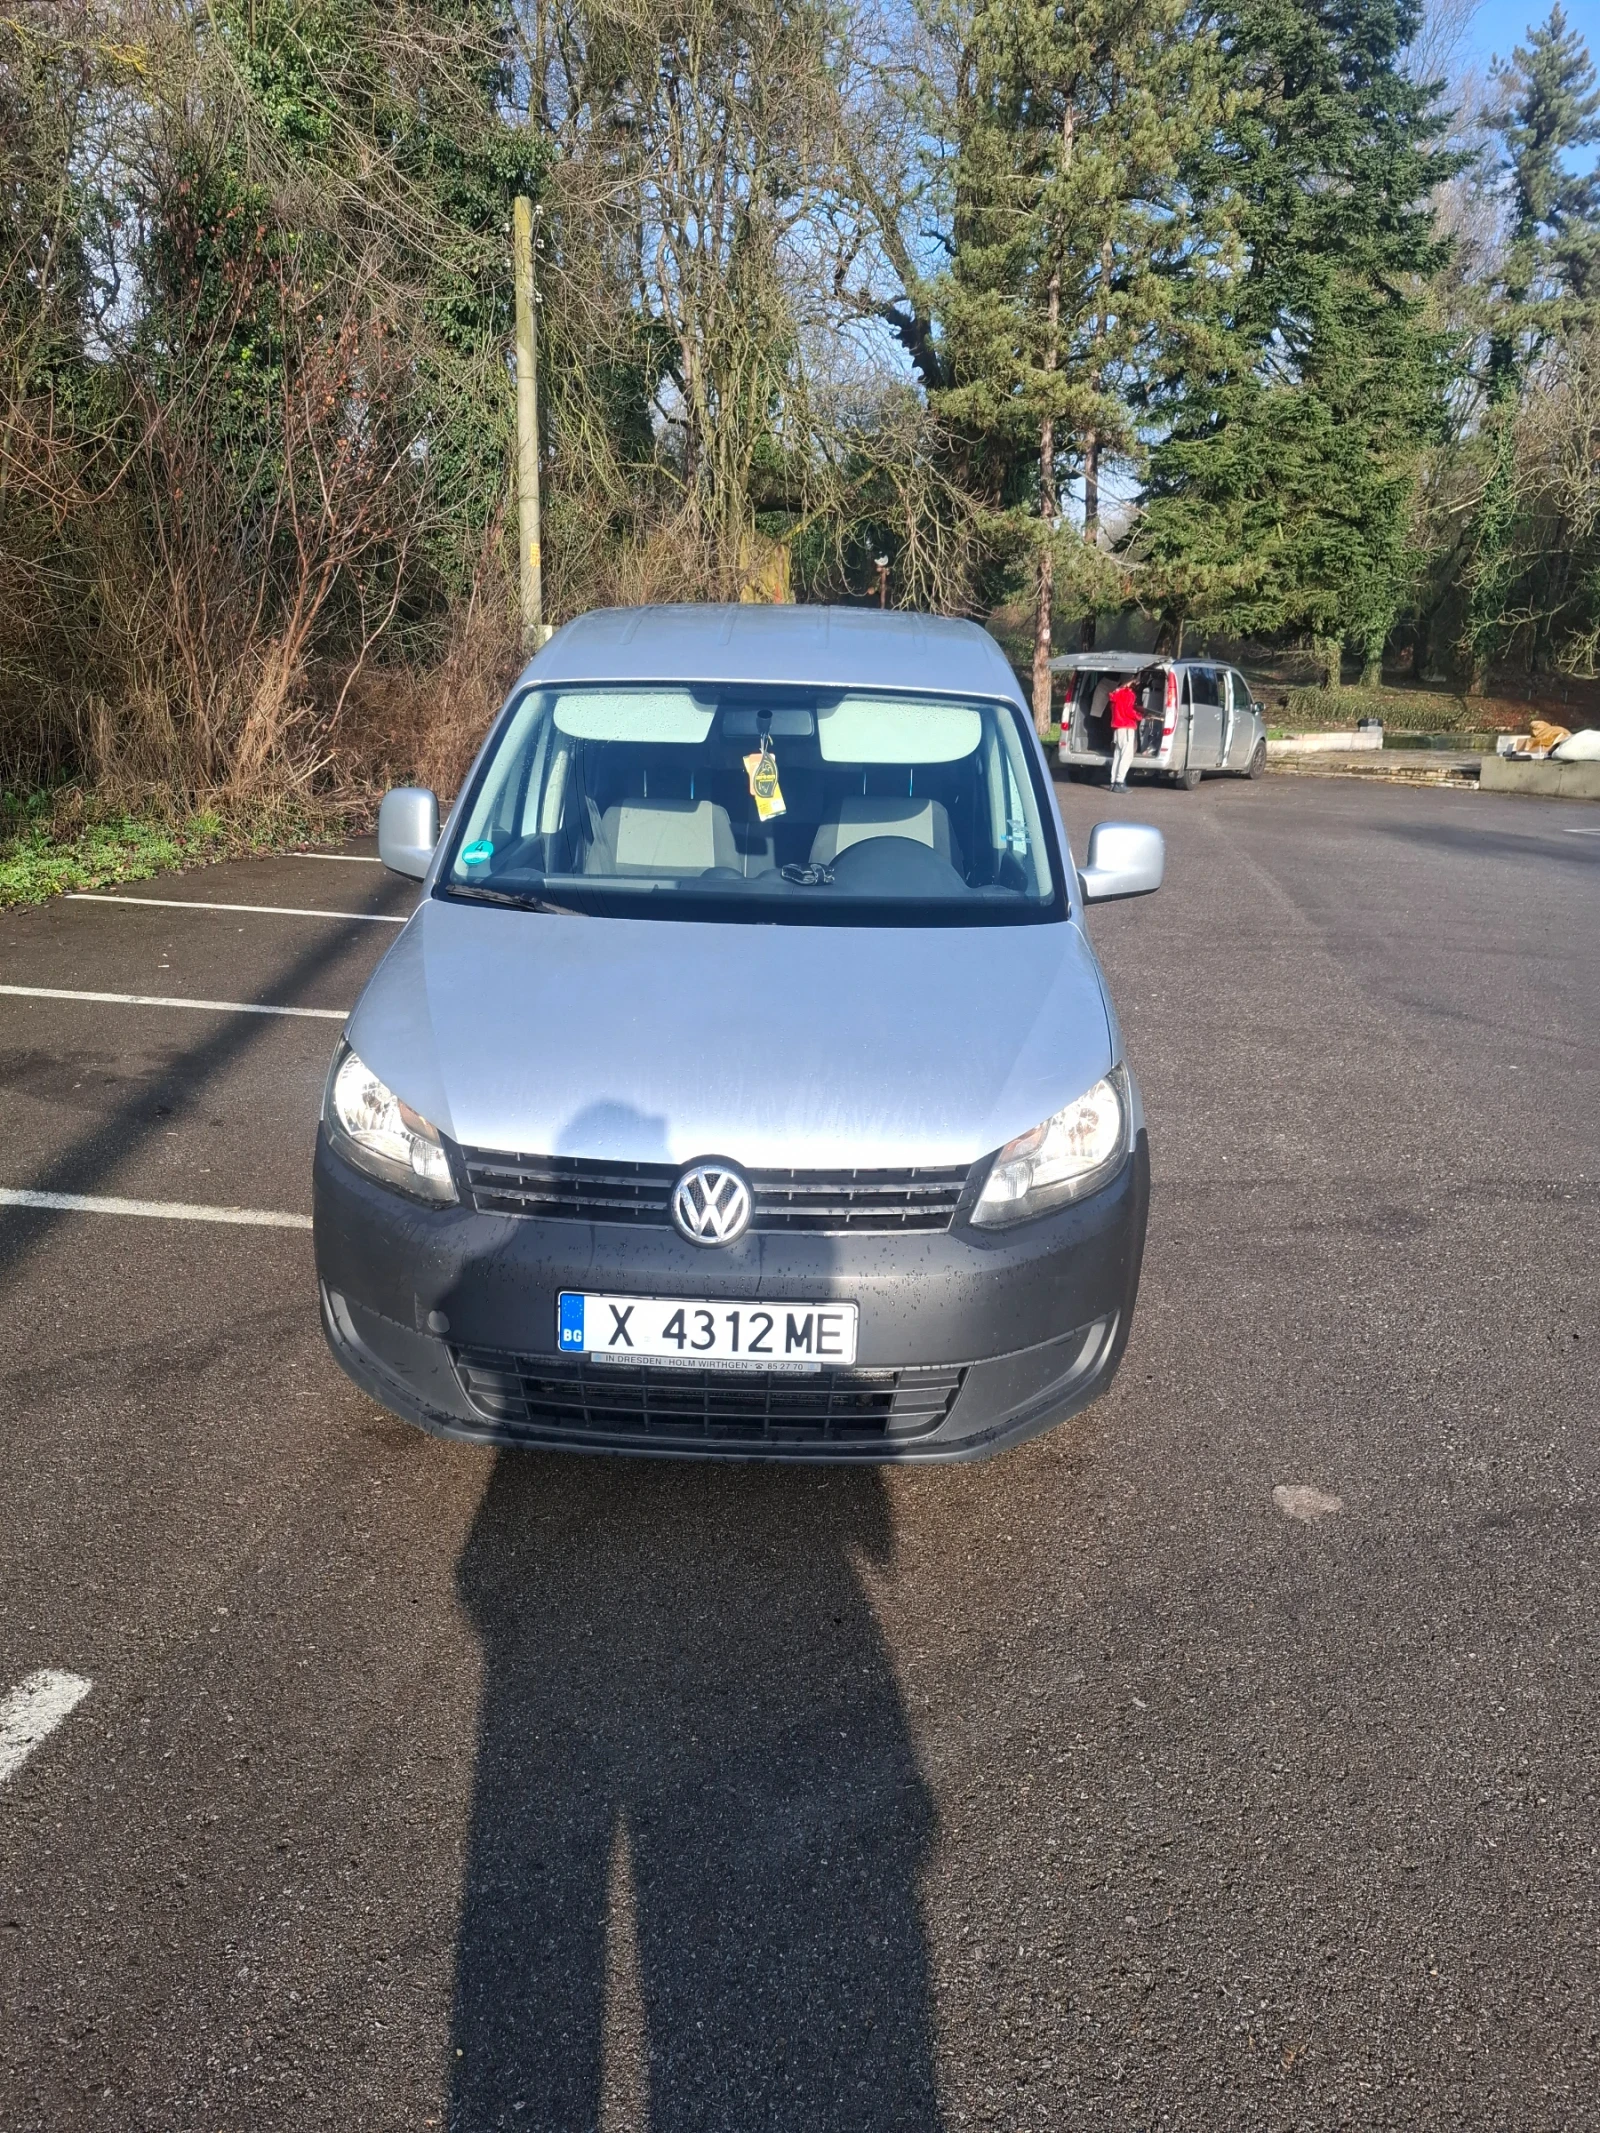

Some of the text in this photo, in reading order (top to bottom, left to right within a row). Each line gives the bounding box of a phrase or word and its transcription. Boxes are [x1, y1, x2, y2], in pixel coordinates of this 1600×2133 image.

[475, 841, 484, 852] 4
[608, 1304, 635, 1347] X
[563, 1328, 582, 1343] BG
[605, 1354, 615, 1362] IN
[617, 1355, 662, 1365] DRESDEN
[668, 1359, 695, 1367] HOLM
[697, 1360, 748, 1369] WIRTHGEN
[767, 1362, 778, 1370] 85
[793, 1363, 803, 1371] 70
